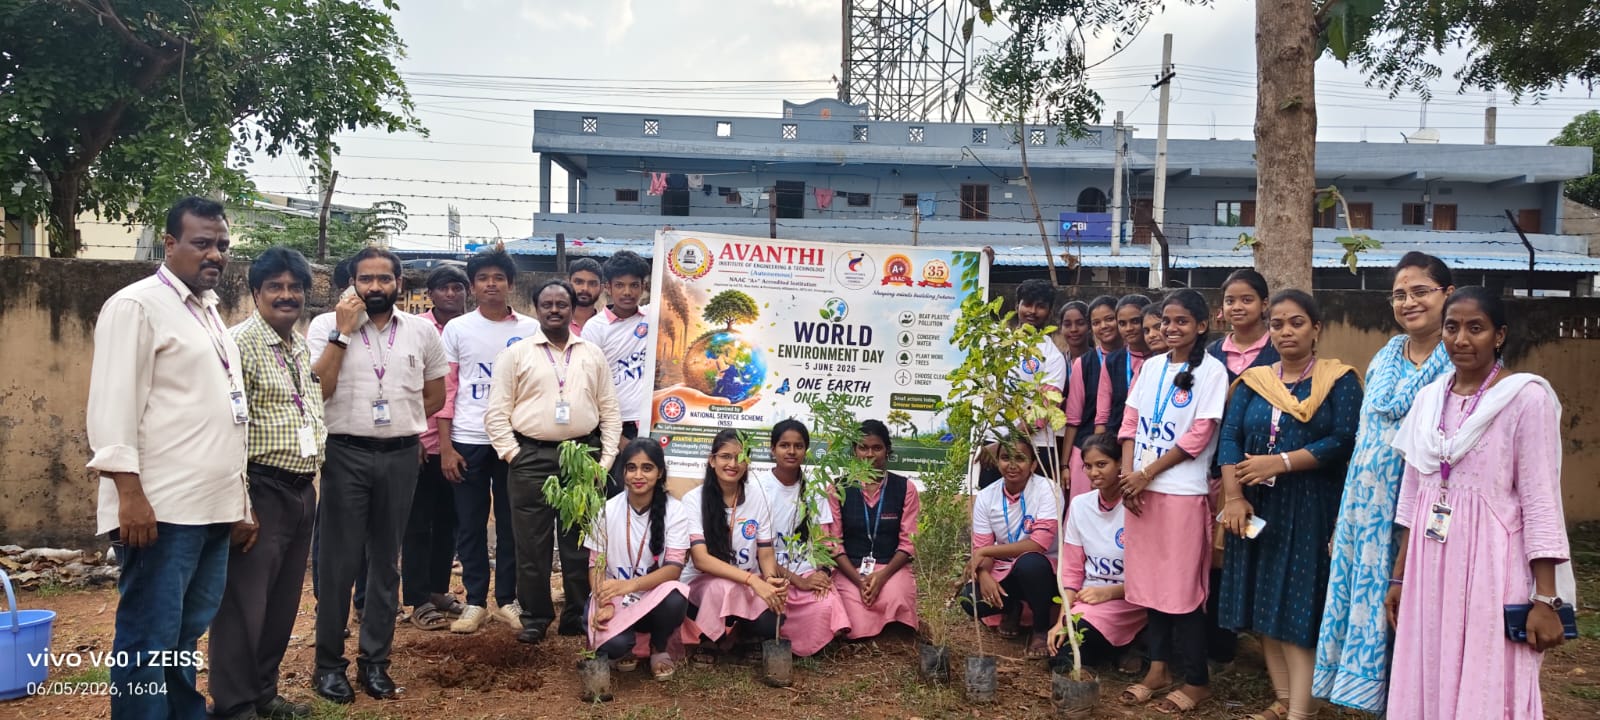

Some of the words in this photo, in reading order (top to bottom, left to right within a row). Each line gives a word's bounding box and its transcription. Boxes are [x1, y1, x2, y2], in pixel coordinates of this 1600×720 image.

[718, 242, 825, 266] AVANTHI
[750, 270, 792, 278] (Autonomous)
[892, 265, 904, 273] A+
[928, 266, 944, 276] 35
[794, 321, 872, 346] WORLD
[778, 344, 859, 362] ENVIRONMENT
[862, 349, 885, 363] DAY
[813, 363, 833, 371] JUNE
[837, 364, 856, 372] 2026
[796, 378, 823, 390] ONE
[827, 380, 871, 393] EARTH
[793, 392, 820, 404] ONE
[1088, 556, 1124, 576] NSS
